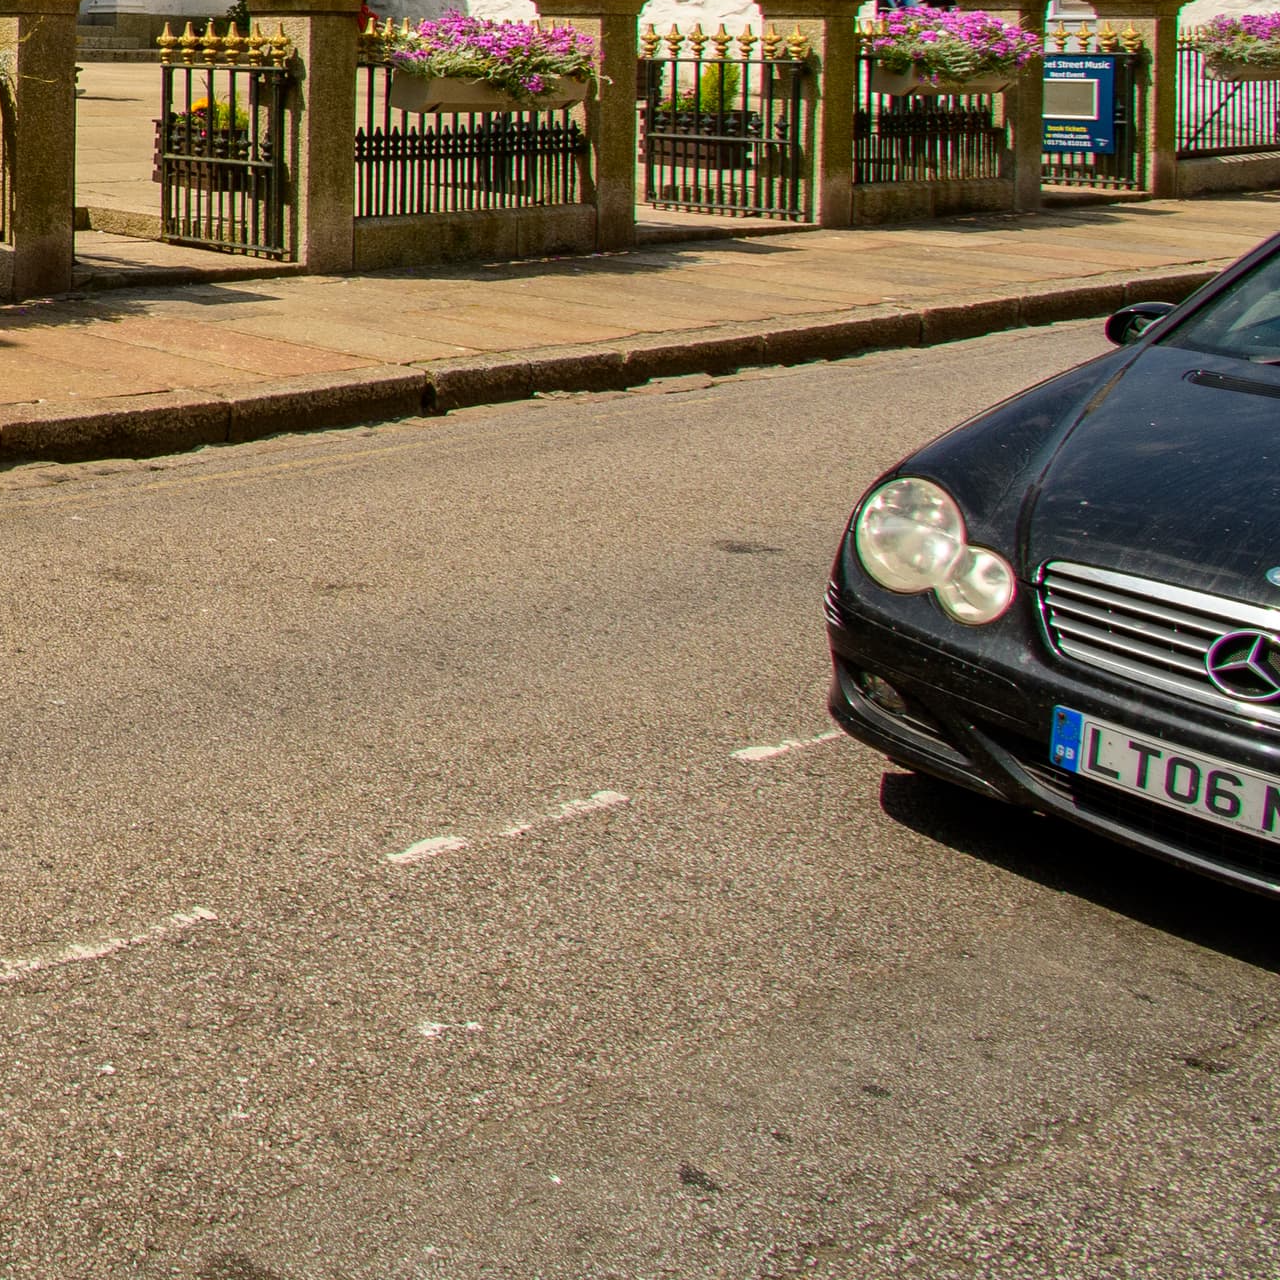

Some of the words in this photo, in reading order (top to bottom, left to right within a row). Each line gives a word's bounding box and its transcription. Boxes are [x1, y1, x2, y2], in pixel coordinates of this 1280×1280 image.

[1057, 61, 1084, 69] Street
[1085, 61, 1110, 70] Music
[1055, 744, 1075, 760] GB
[1087, 727, 1243, 818] LT06
